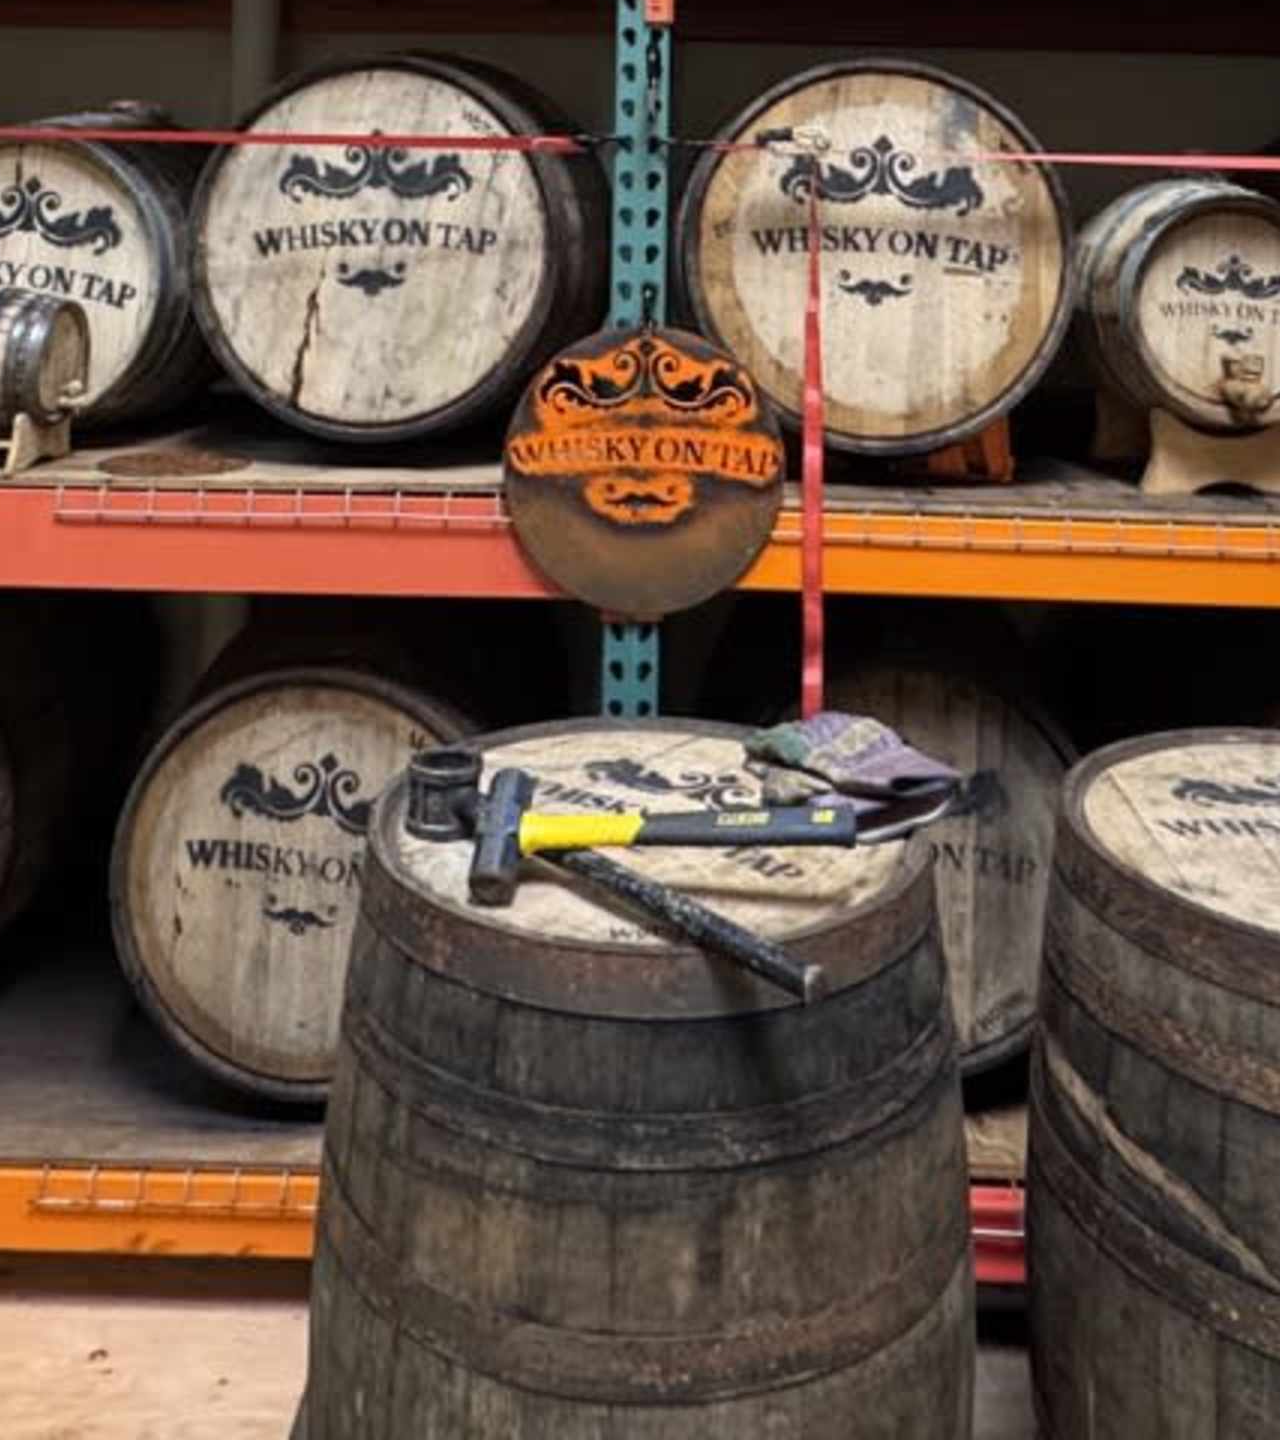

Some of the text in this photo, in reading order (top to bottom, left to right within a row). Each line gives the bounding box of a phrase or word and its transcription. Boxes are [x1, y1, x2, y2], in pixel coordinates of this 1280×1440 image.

[253, 219, 497, 257] WHISKY ON TAP
[751, 226, 1010, 273] WHSKY ON TAP
[28, 265, 75, 291] ON
[77, 272, 137, 310] TAP
[1158, 299, 1232, 321] WHISKY
[1236, 305, 1265, 325] ON
[511, 436, 779, 476] WHISKY ON TAP
[186, 839, 313, 878] WHISKY
